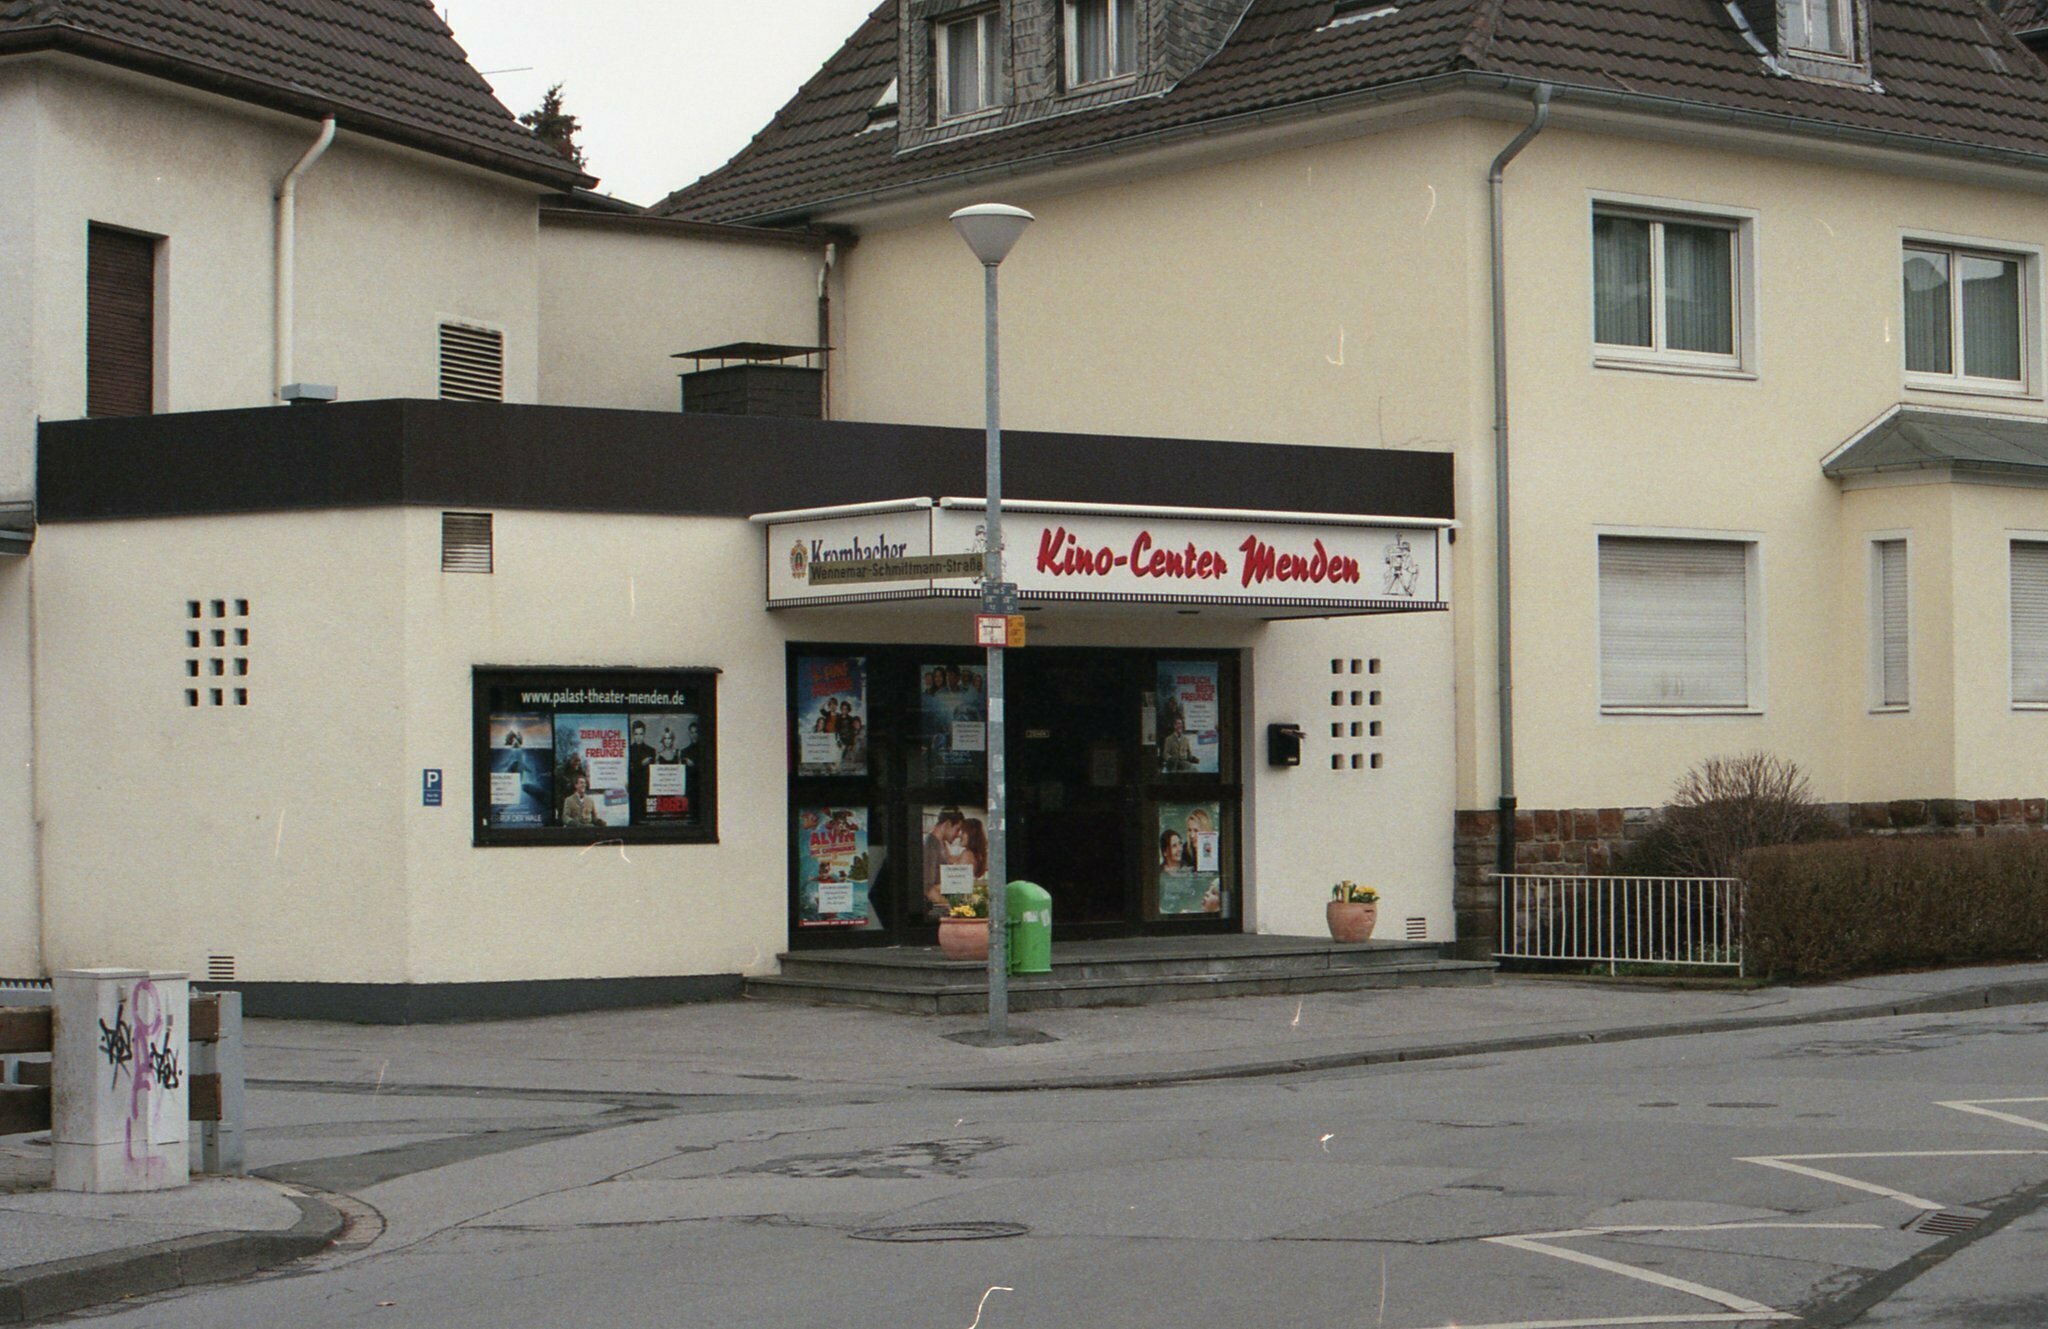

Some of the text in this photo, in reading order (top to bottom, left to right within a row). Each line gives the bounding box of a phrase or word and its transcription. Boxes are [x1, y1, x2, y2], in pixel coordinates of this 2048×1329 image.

[1036, 526, 1361, 589] Kino-Center Menden
[811, 557, 983, 581] Wennemar-Schmittmann-Straße
[521, 688, 686, 707] www.palast-theater-menden.de
[602, 739, 627, 748] BESTE
[585, 748, 625, 758] FREUNDE
[427, 771, 439, 788] P
[810, 831, 856, 846] ALVIN
